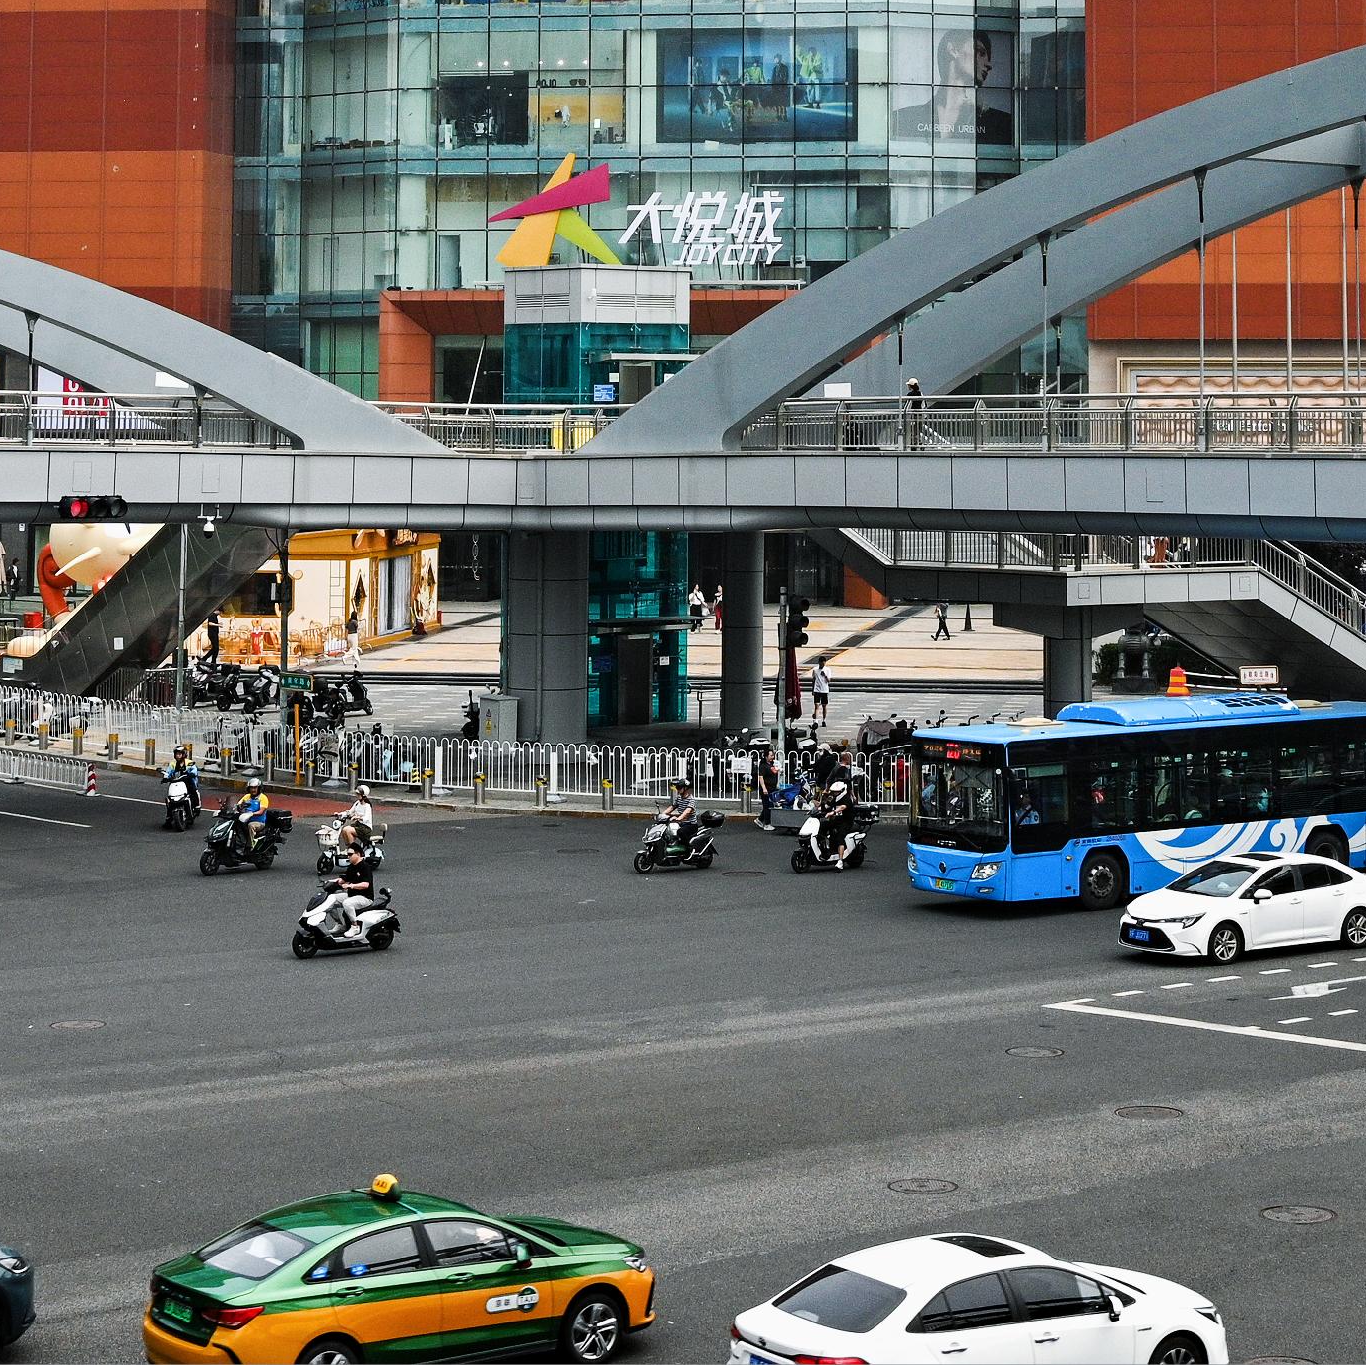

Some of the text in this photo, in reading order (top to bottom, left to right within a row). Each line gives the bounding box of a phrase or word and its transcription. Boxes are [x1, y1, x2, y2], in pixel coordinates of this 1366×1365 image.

[618, 190, 785, 244] 大悦城
[672, 243, 784, 266] JOY CITY
